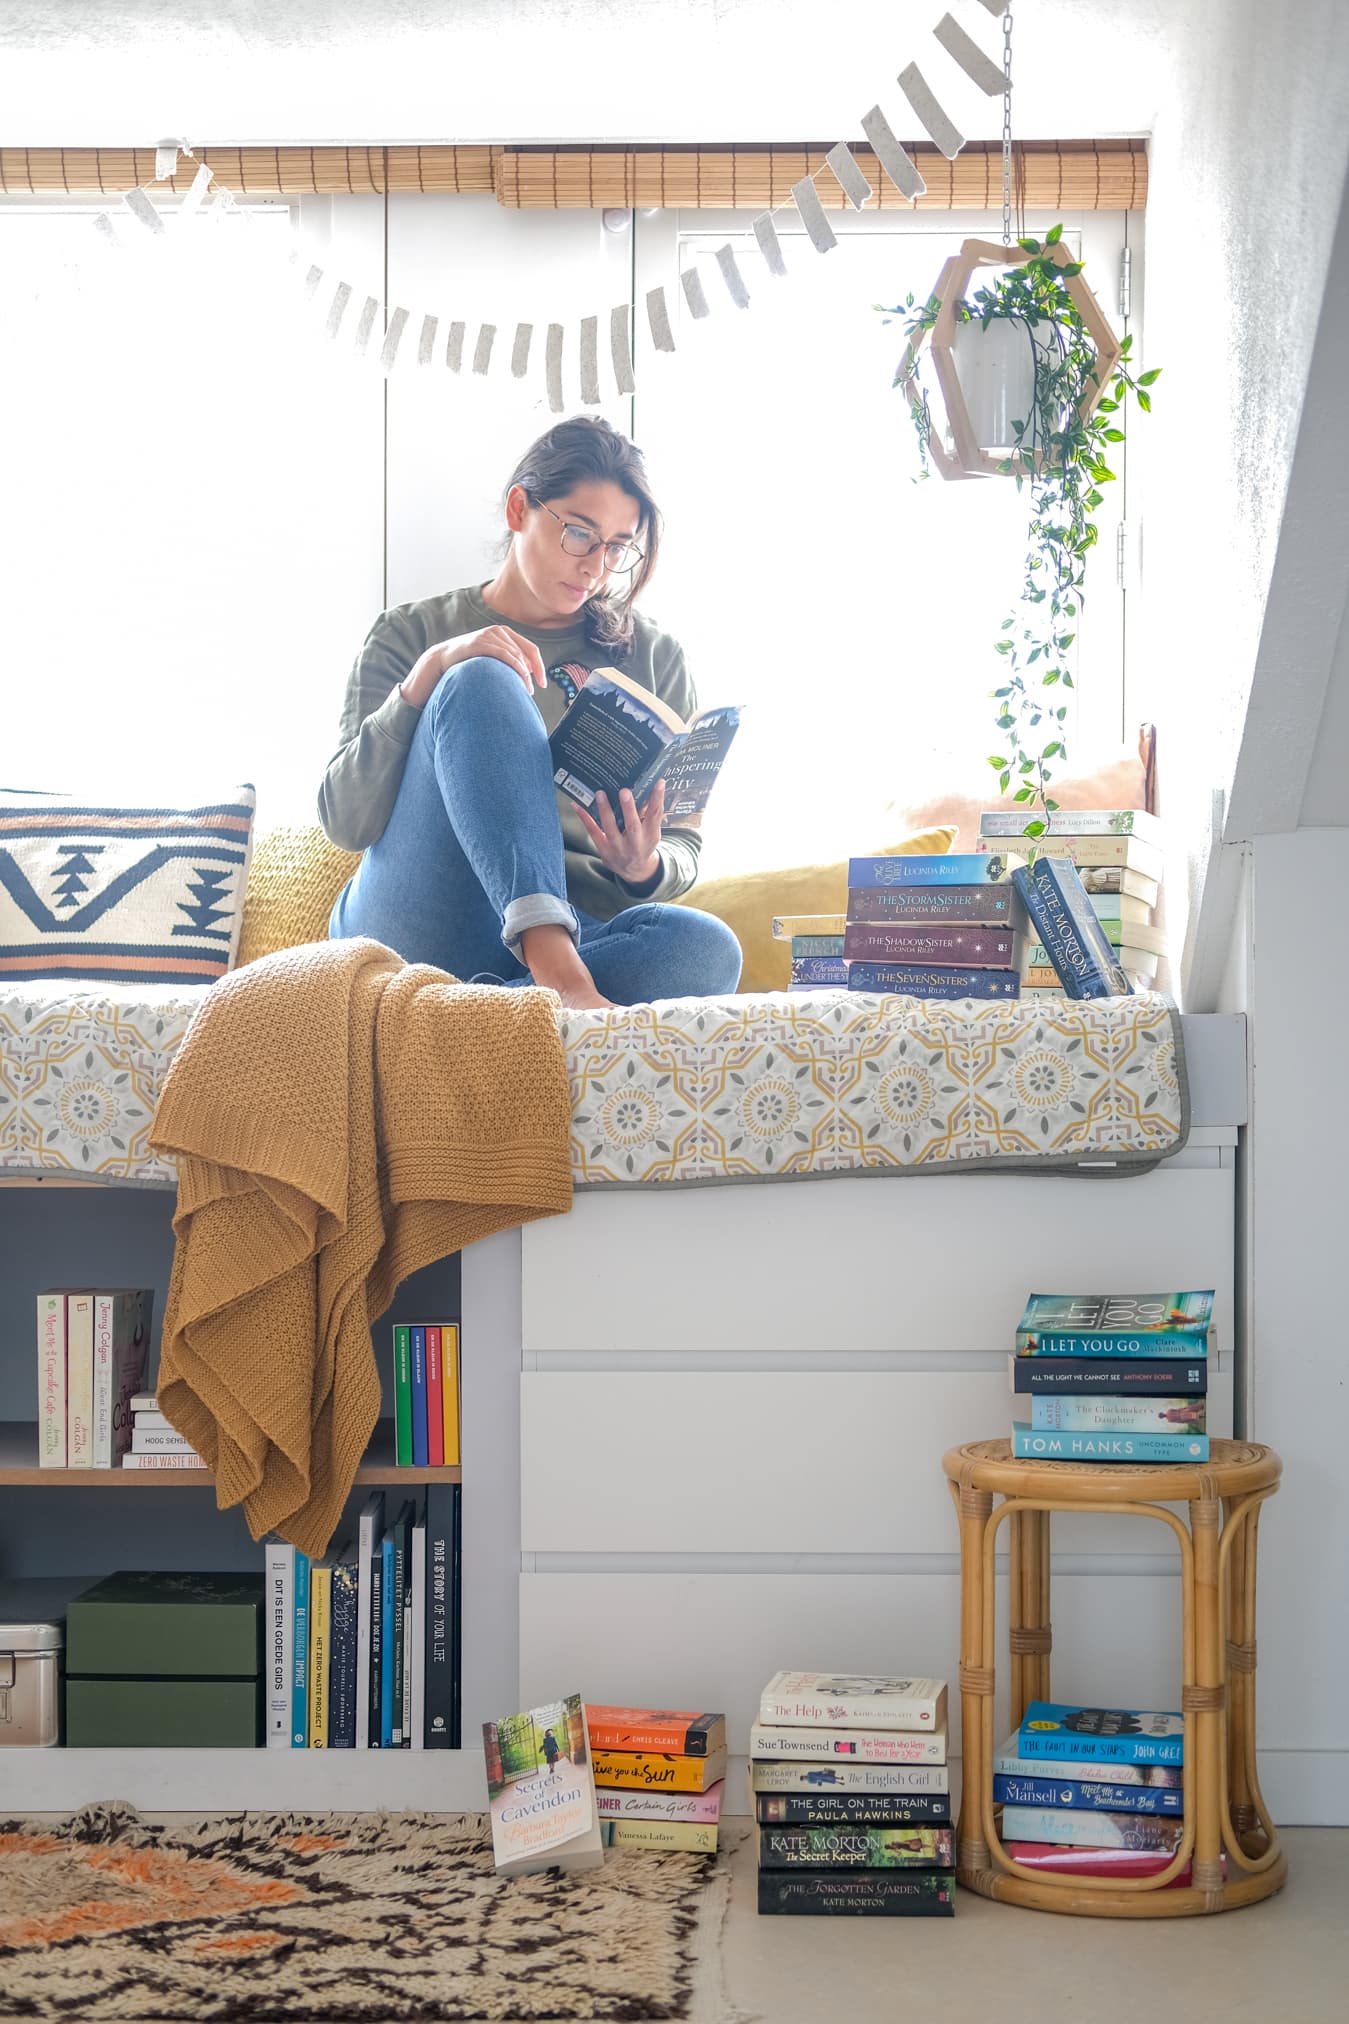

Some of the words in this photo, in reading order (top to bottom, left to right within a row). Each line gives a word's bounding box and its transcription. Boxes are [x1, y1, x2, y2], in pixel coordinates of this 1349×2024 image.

[682, 754, 696, 763] The
[663, 758, 721, 776] hispering
[666, 776, 696, 793] City
[895, 906, 929, 914] LUCINDA
[930, 906, 951, 914] RILEY
[1036, 874, 1061, 912] KATE
[1052, 913, 1090, 976] MORTON
[1035, 904, 1055, 940] Distant
[1051, 940, 1068, 970] Hours
[811, 960, 848, 973] Christma
[800, 973, 826, 981] UNDER
[827, 973, 840, 981] THE
[894, 985, 926, 994] LUCINDA
[928, 986, 947, 995] RILEY
[98, 1302, 111, 1330] Jenny
[1064, 1302, 1100, 1327] LET
[1103, 1299, 1138, 1329] YOU
[1134, 1303, 1165, 1325] GO
[98, 1331, 111, 1364] Colgan
[1050, 1339, 1077, 1352] LET
[1081, 1339, 1115, 1352] YOU
[1117, 1339, 1140, 1352] GO
[1076, 1406, 1092, 1414] The
[1094, 1416, 1135, 1426] Daughter
[74, 1416, 82, 1454] COLGAN
[145, 1437, 164, 1445] HOOG
[1023, 1438, 1062, 1451] TOM
[1072, 1440, 1134, 1454] HANKS
[138, 1455, 157, 1467] ZERO
[159, 1455, 184, 1467] WASTE
[433, 1539, 445, 1561] THE
[275, 1579, 283, 1595] DIT
[433, 1565, 445, 1601] STORY
[275, 1596, 283, 1606] IS
[296, 1607, 305, 1617] DE
[434, 1603, 445, 1616] OF
[275, 1608, 283, 1629] EEN
[433, 1618, 445, 1640] YOUR
[275, 1630, 283, 1664] GOEDE
[433, 1642, 445, 1663] LIFE
[274, 1667, 283, 1691] GIDS
[295, 1660, 305, 1689] IMPACT
[314, 1697, 322, 1729] PROJECT
[774, 1704, 791, 1716] The
[795, 1704, 822, 1719] Help
[632, 1735, 652, 1745] CHRIS
[654, 1736, 679, 1745] CLEAVE
[758, 1739, 777, 1750] Sue
[779, 1738, 829, 1751] Townsend
[1024, 1741, 1040, 1752] THE
[1070, 1743, 1079, 1753] IN
[1081, 1744, 1096, 1754] OUR
[1133, 1744, 1156, 1759] JOHN
[615, 1766, 630, 1781] you
[643, 1764, 675, 1783] Sun
[849, 1774, 863, 1784] The
[865, 1771, 905, 1788] English
[908, 1771, 929, 1785] Girl
[515, 1775, 563, 1797] Secrets
[534, 1790, 545, 1801] of
[1005, 1787, 1056, 1803] Mansell
[501, 1787, 582, 1824] Cavendon
[597, 1798, 621, 1810] INER
[625, 1801, 665, 1811] Certain
[791, 1799, 813, 1809] THE
[818, 1799, 844, 1809] GIRL
[848, 1799, 864, 1809] ON
[868, 1799, 890, 1809] THE
[894, 1799, 928, 1808] TRAIN
[808, 1811, 848, 1820] PAULA
[855, 1810, 911, 1820] HAWKINS
[618, 1831, 647, 1840] Vanessa
[649, 1832, 675, 1843] Lafaye
[770, 1836, 809, 1850] KATE
[813, 1836, 880, 1853] MORTON
[786, 1853, 798, 1862] The
[799, 1851, 829, 1862] Secret
[832, 1851, 866, 1864] Keeper
[787, 1884, 806, 1894] THE
[806, 1880, 874, 1895] FORGOTTEN
[877, 1882, 920, 1896] GARDEN
[823, 1898, 845, 1906] KATE
[847, 1898, 885, 1907] MORTON
